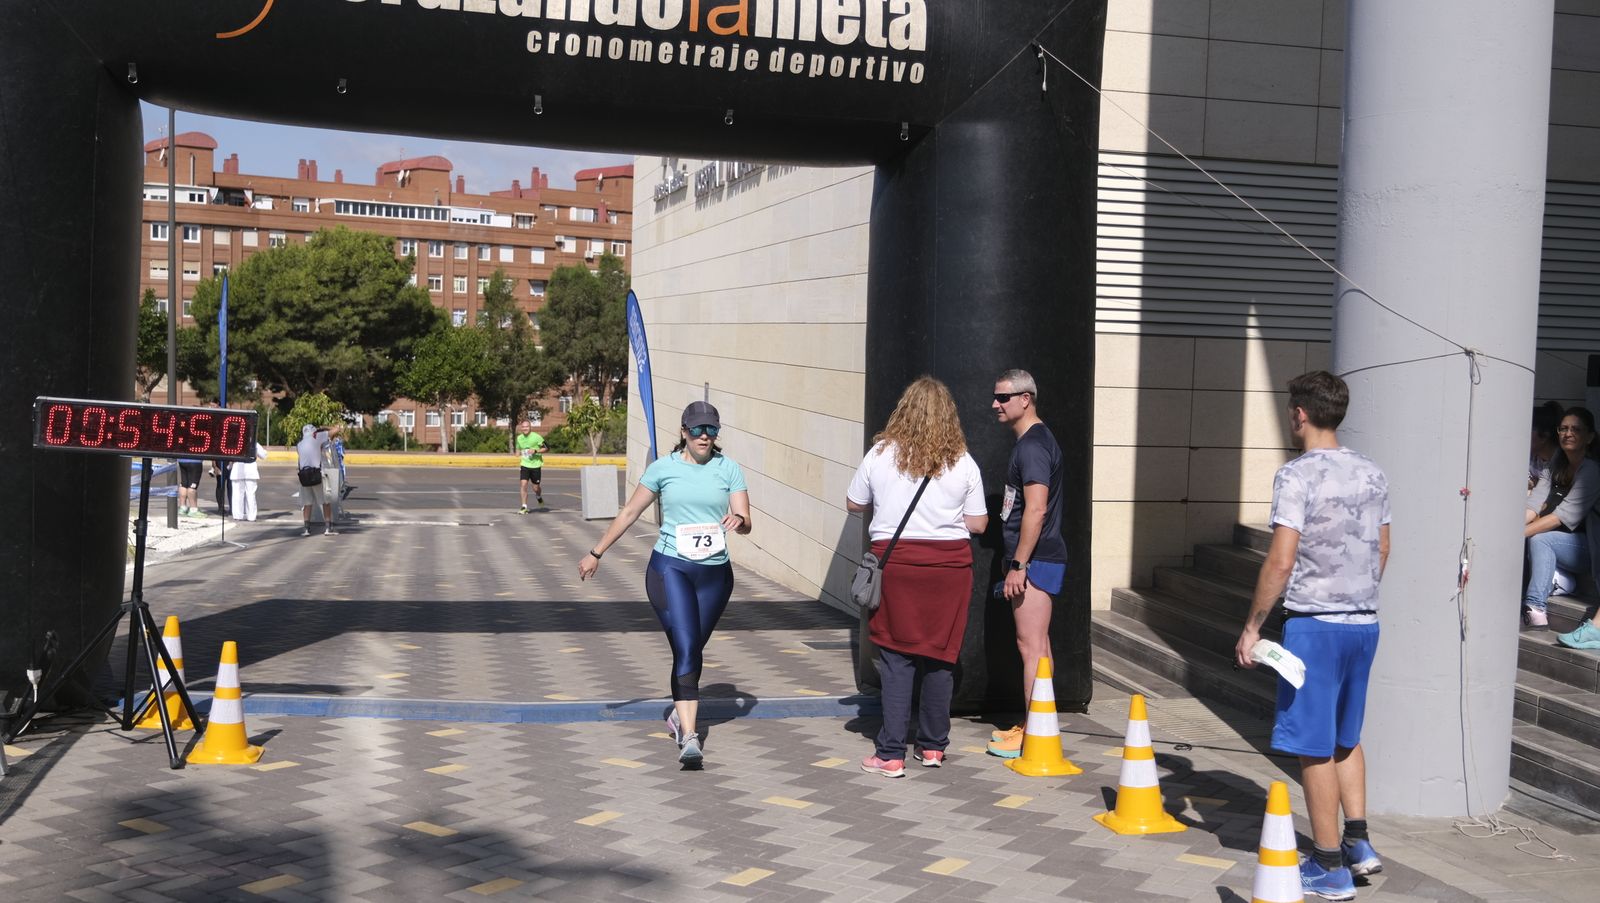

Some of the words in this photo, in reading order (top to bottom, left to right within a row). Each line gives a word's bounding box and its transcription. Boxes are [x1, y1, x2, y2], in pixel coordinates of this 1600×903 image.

[526, 30, 760, 72] cronometraje
[769, 47, 925, 84] deportivo
[46, 404, 247, 455] 00:54:50
[692, 535, 713, 548] 73
